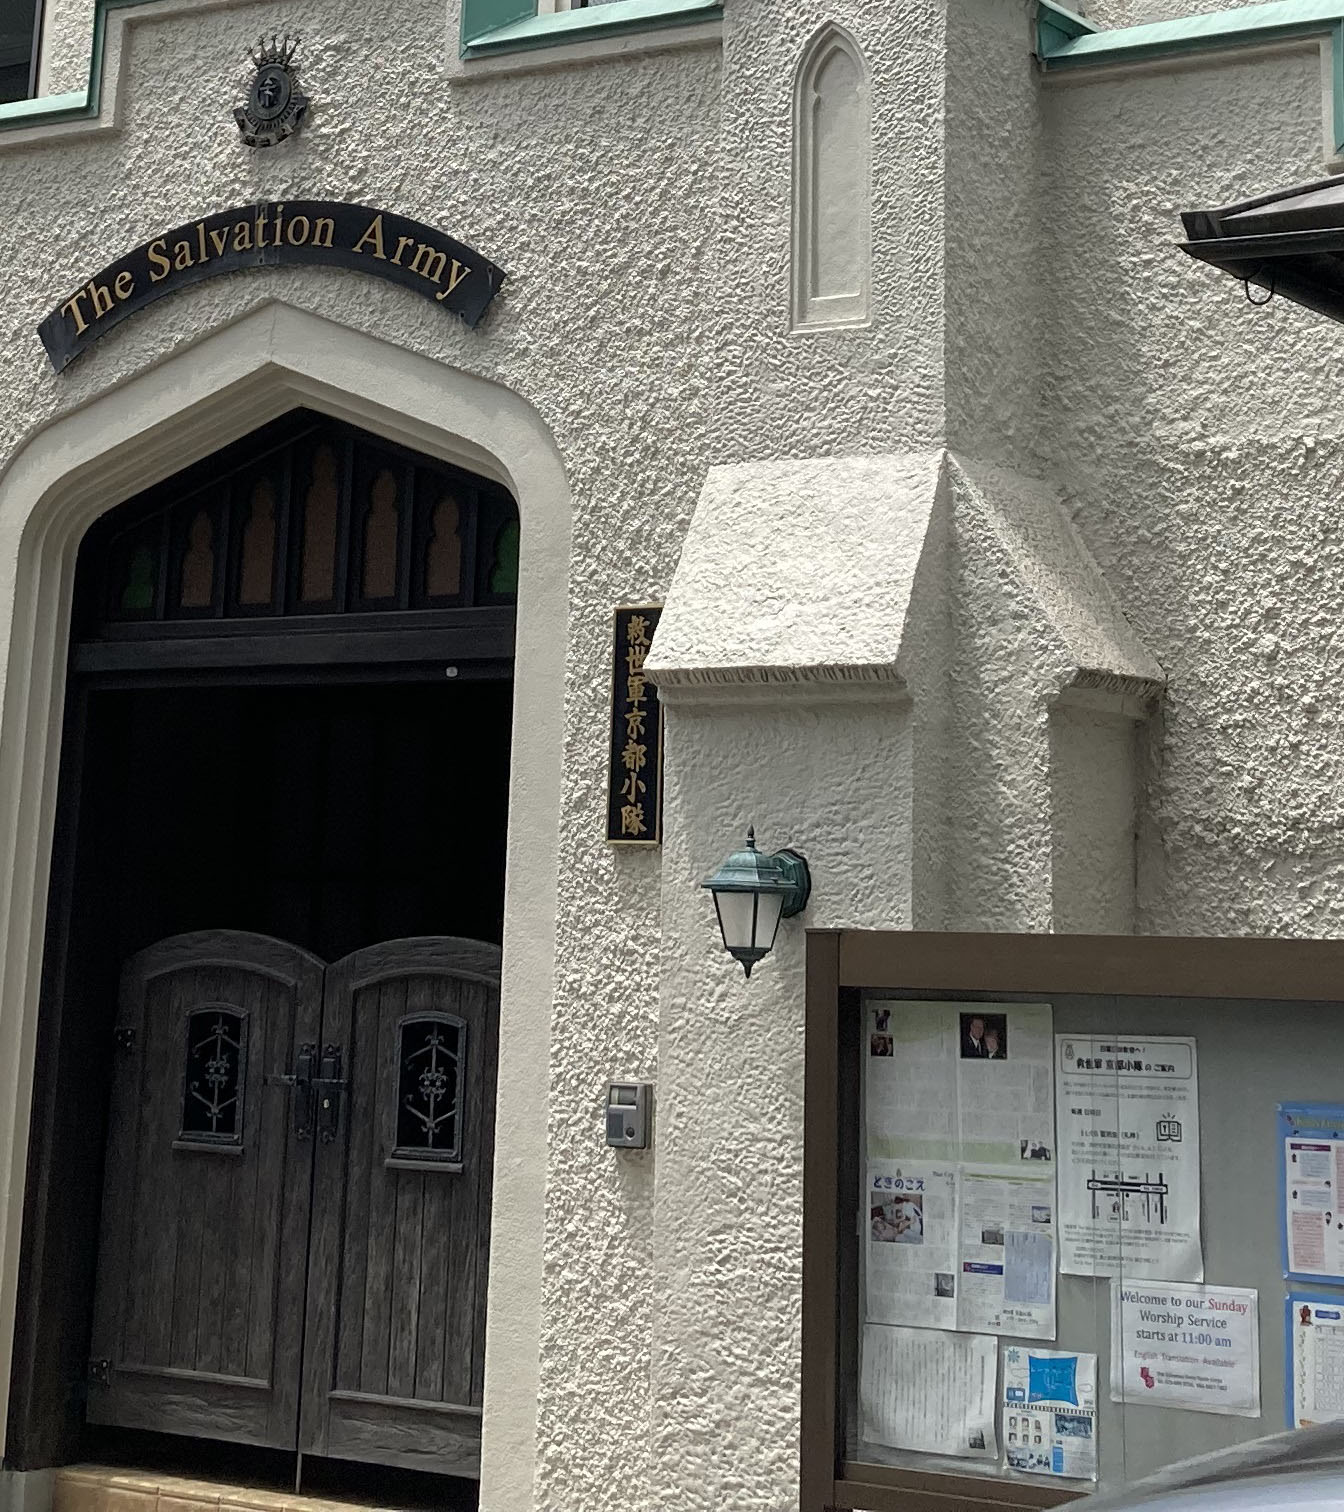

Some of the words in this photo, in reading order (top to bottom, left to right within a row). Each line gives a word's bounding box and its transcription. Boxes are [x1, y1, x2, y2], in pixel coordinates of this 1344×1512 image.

[60, 269, 135, 336] The
[146, 205, 335, 279] Salvation
[352, 214, 473, 300] Army
[620, 615, 651, 836] 救世軍京都小隊
[873, 1176, 925, 1191] ときのこえ
[1120, 1291, 1167, 1306] Welcome
[1170, 1296, 1182, 1307] to
[1186, 1298, 1205, 1308] our
[1208, 1298, 1248, 1315] Sunday
[1140, 1310, 1184, 1328] Worship
[1188, 1315, 1227, 1329] Service
[1136, 1329, 1165, 1341] starts
[1168, 1332, 1178, 1342] at
[1182, 1332, 1212, 1346] 11:00
[1215, 1337, 1232, 1347] am
